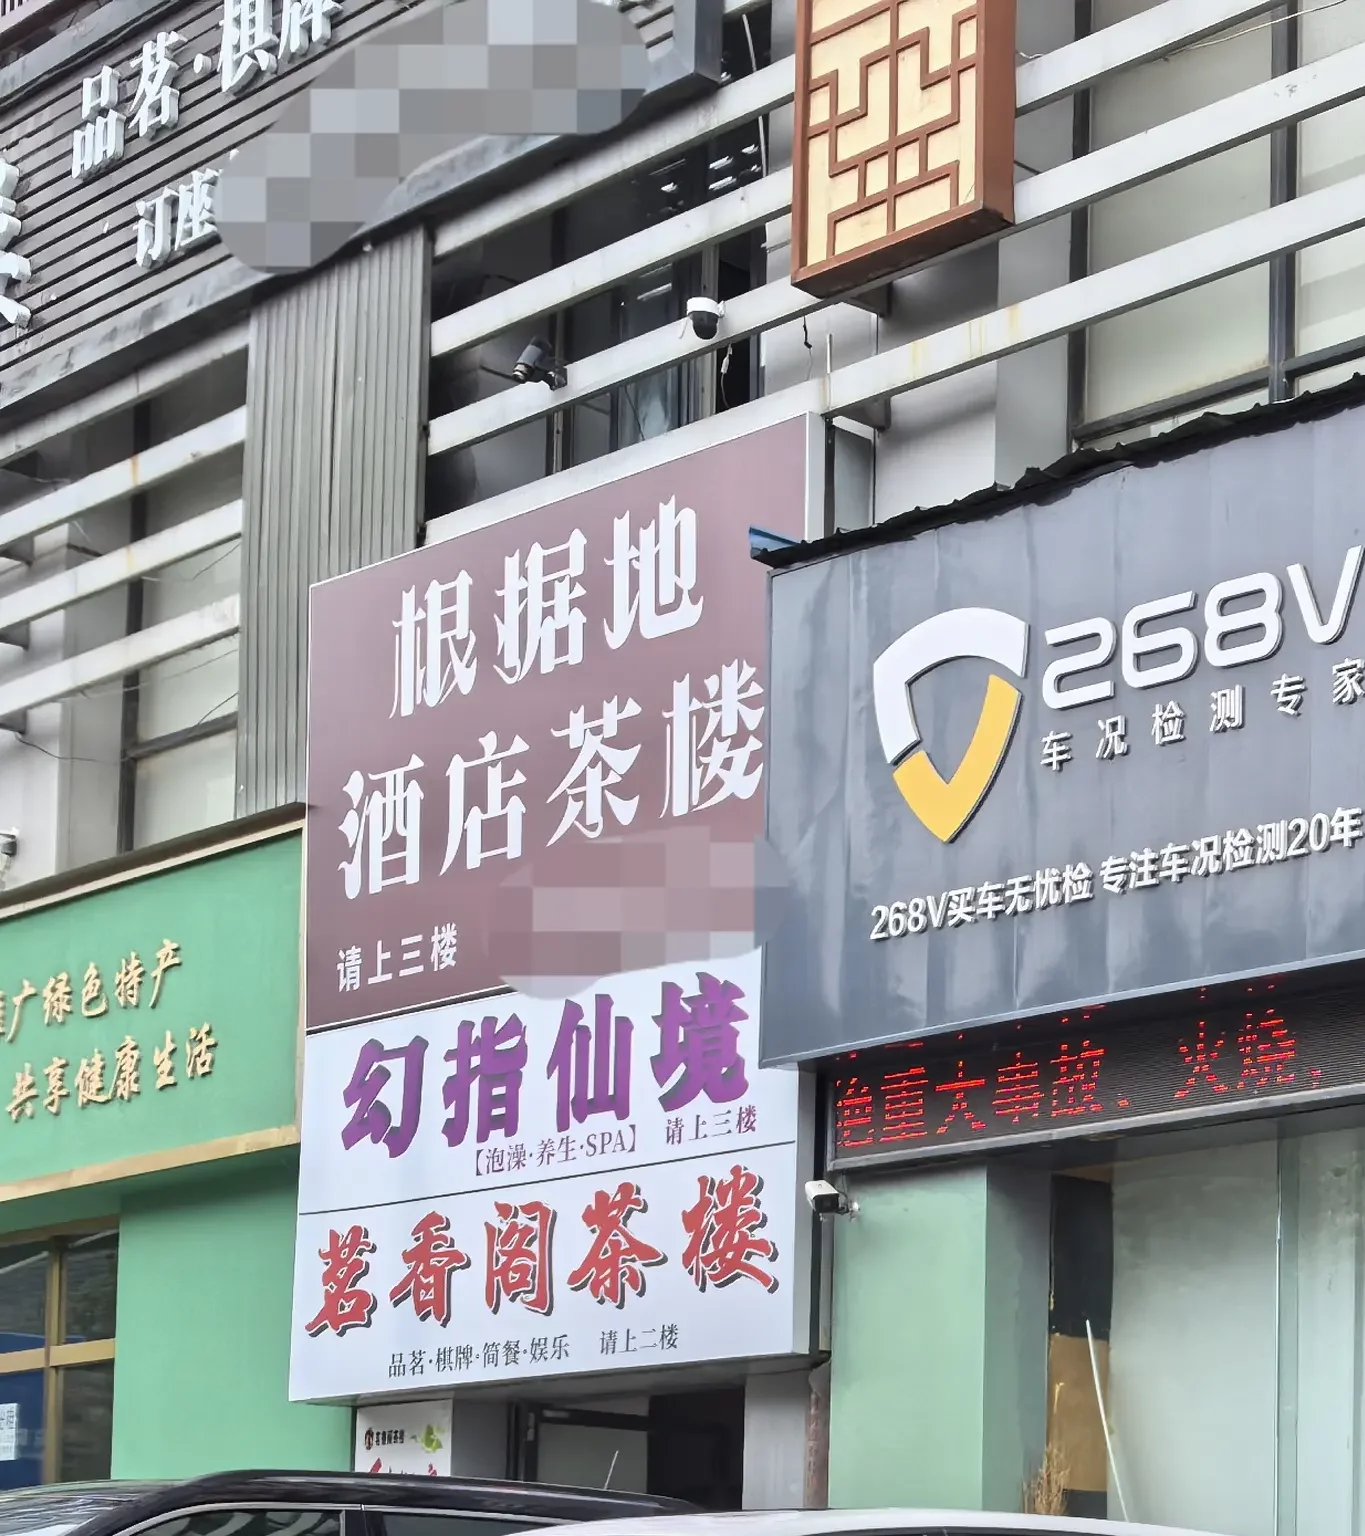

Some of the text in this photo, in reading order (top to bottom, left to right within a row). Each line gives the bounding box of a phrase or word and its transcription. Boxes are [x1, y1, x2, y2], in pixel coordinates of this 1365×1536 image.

[389, 495, 704, 720] 根据地
[337, 658, 766, 900] 酒店茶楼
[869, 806, 1365, 941] 268V买车无忧检 专注车况检测20年
[0, 937, 183, 1042] 广绿色特产
[336, 922, 458, 994] 请上三楼
[5, 1021, 217, 1122] 共享健康生活
[341, 972, 751, 1160] 幻指仙境
[665, 1104, 758, 1146] 请上三楼
[305, 1164, 780, 1338] 茗香阁茶楼
[599, 1323, 680, 1357] 请上二楼
